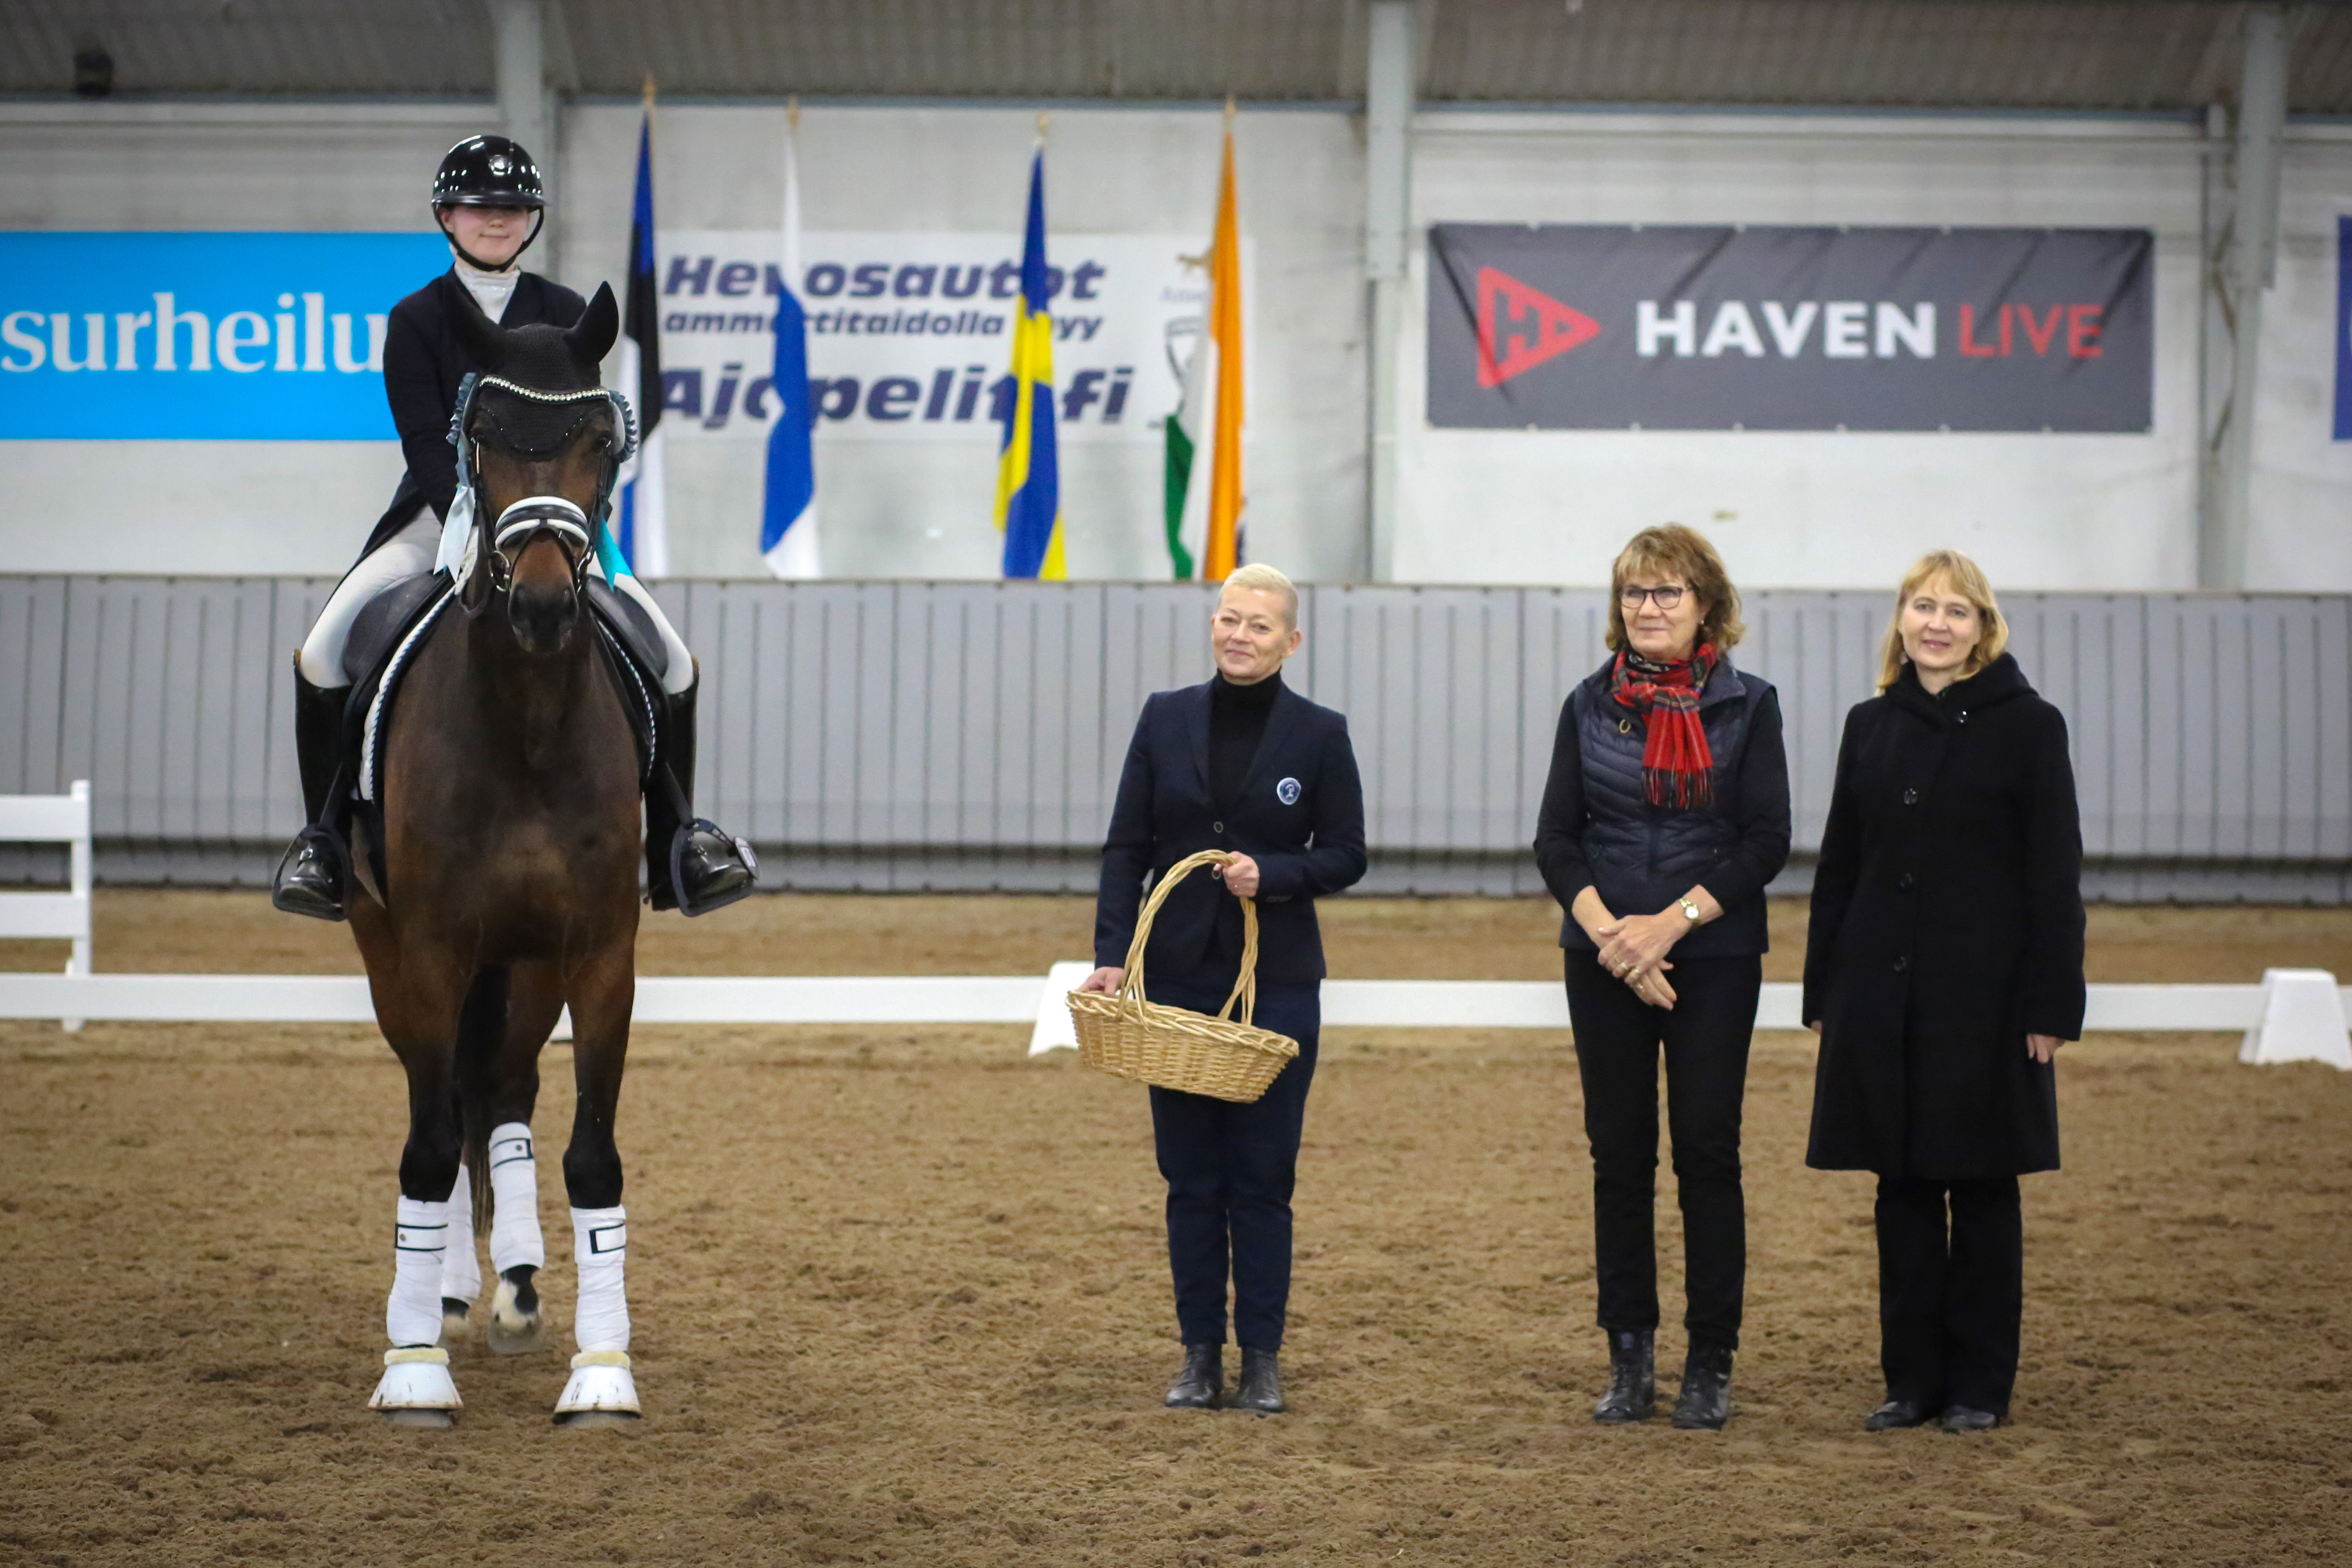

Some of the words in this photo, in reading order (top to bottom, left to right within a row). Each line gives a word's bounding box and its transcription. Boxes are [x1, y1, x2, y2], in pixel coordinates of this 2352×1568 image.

[1, 291, 389, 373] surheilu
[665, 306, 1005, 335] ammtitaidolla
[1052, 317, 1103, 341] yy
[1635, 300, 1937, 358] HAVEN
[1958, 303, 2104, 358] LIVE
[659, 362, 1134, 430] Ajpelifi
